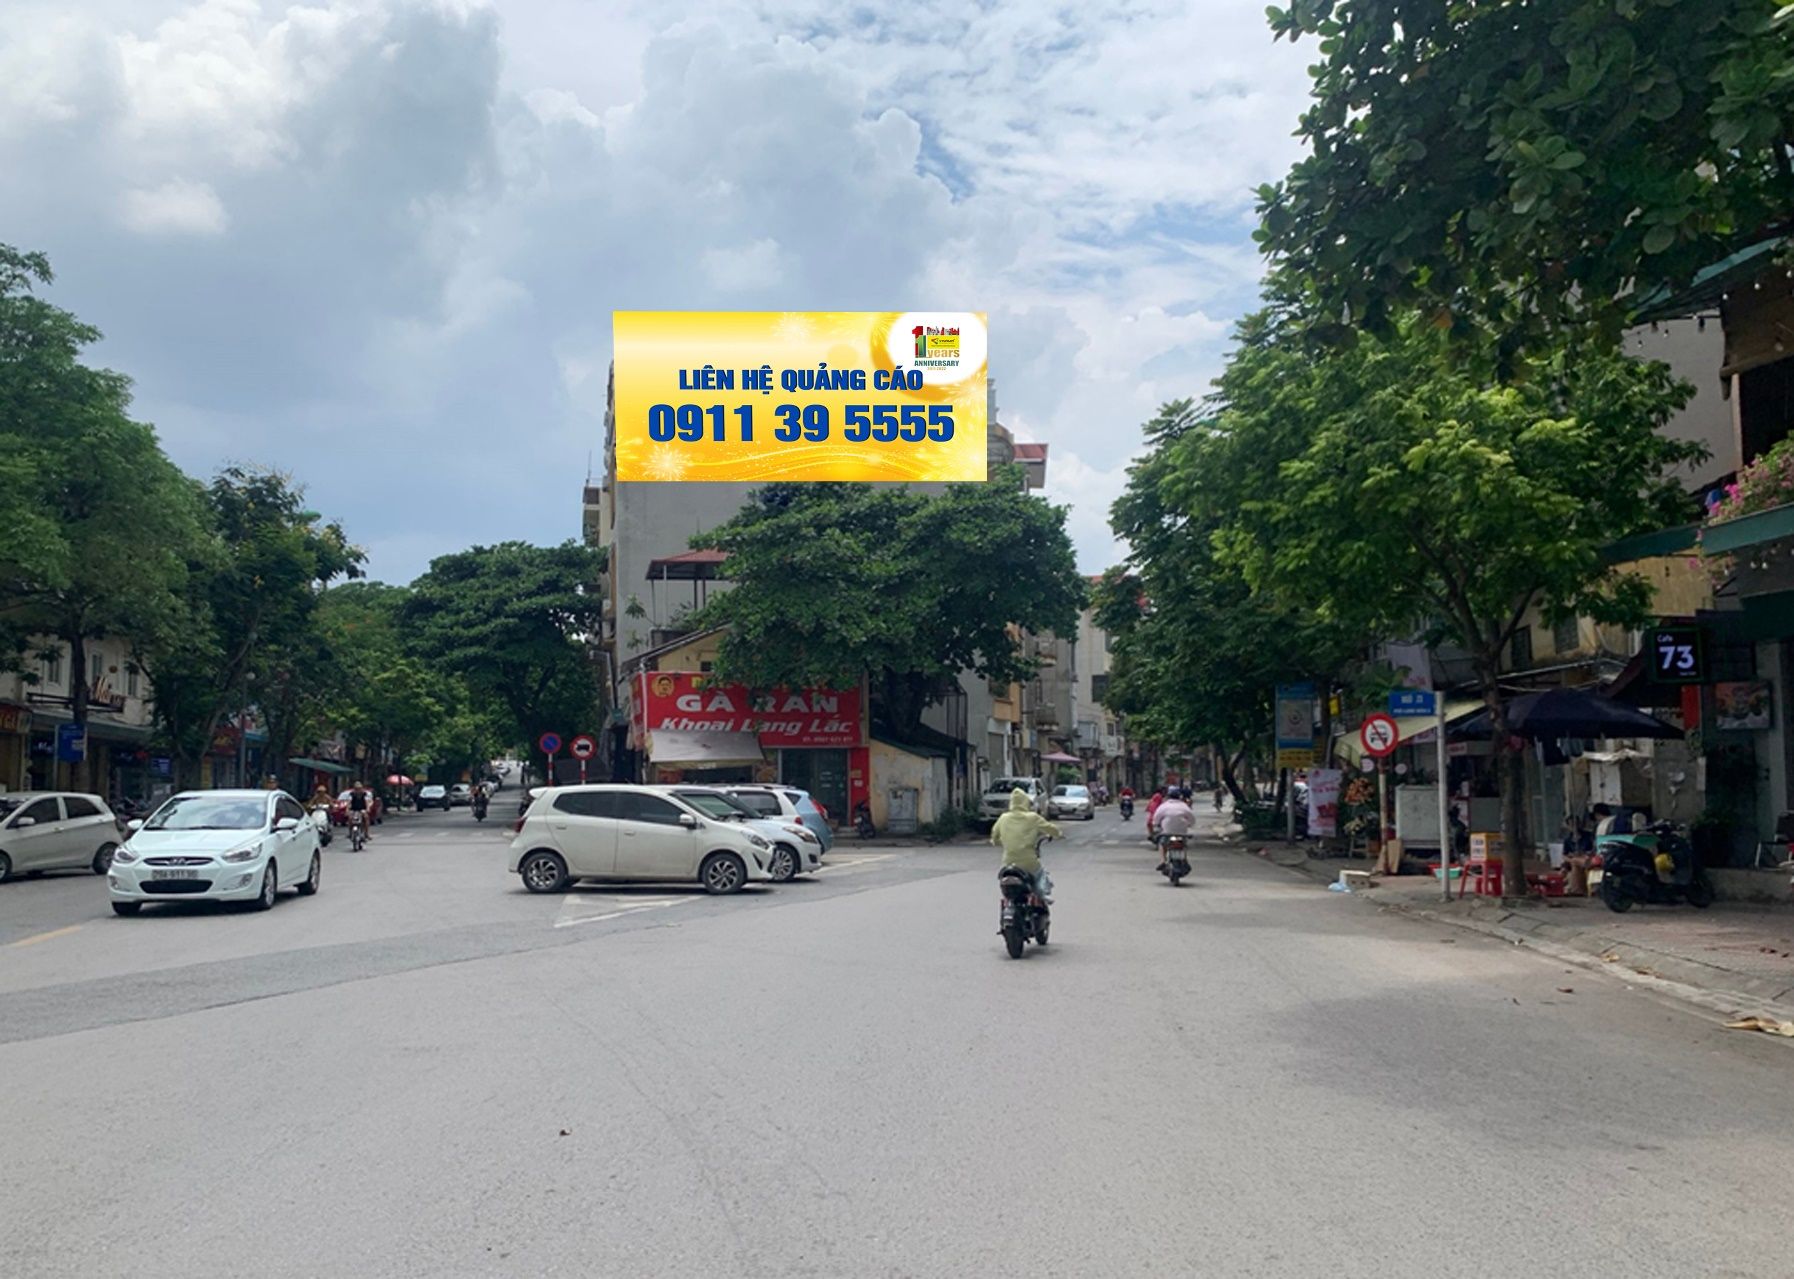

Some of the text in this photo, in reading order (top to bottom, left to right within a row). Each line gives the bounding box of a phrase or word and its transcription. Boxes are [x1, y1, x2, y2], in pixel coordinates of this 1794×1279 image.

[927, 349, 960, 358] years
[679, 363, 924, 395] LIÊN HỆ QUẢNG CÁO
[648, 403, 955, 443] 0911 39 5555
[1659, 645, 1695, 669] 73
[676, 691, 737, 713] GÀ
[660, 717, 735, 732] Khoai
